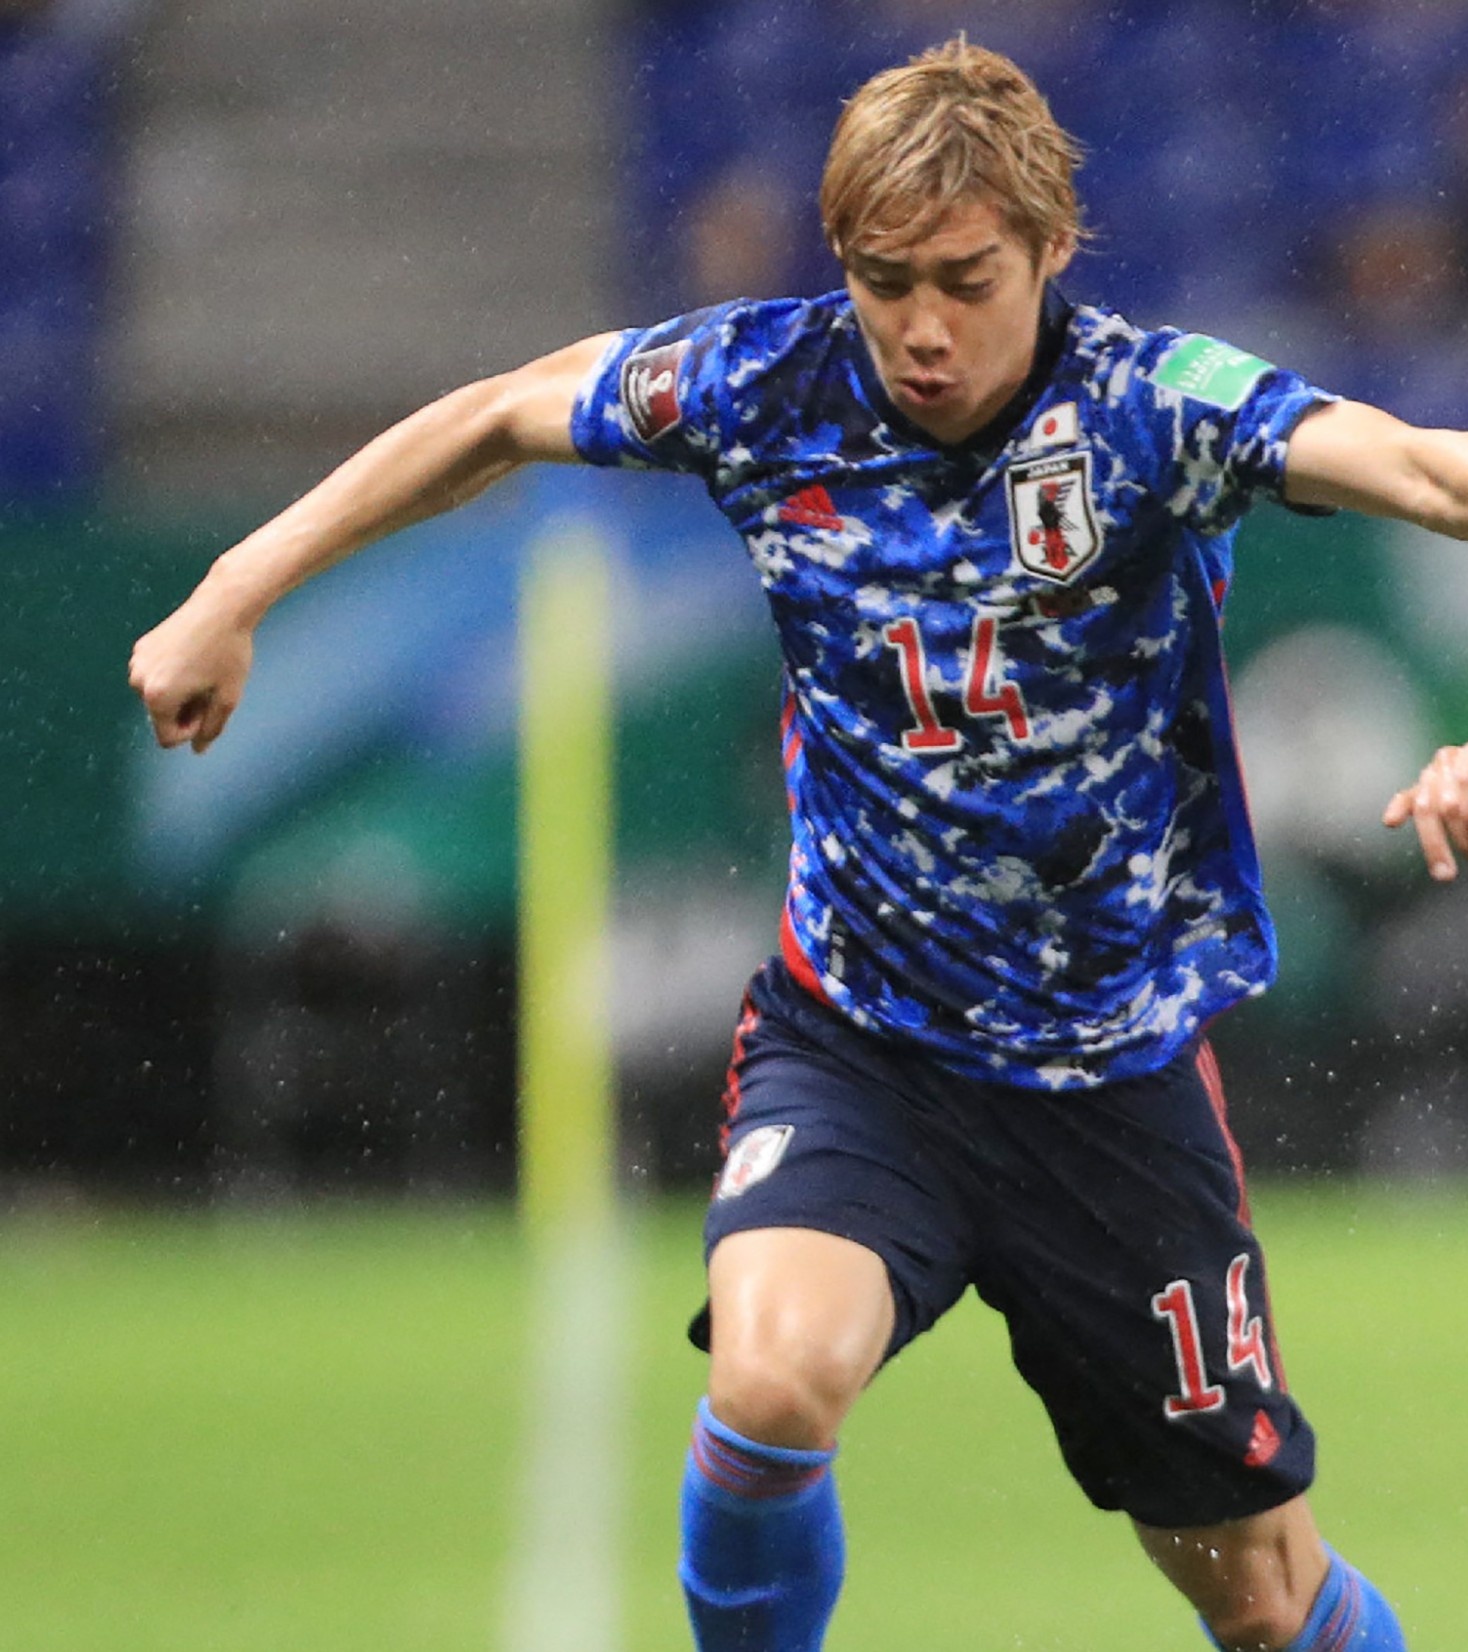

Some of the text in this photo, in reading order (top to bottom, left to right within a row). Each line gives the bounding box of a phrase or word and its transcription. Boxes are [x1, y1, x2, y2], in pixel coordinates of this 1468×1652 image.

[1027, 459, 1071, 479] JAPAN
[882, 607, 1031, 753] 14
[1152, 1253, 1272, 1418] 14
